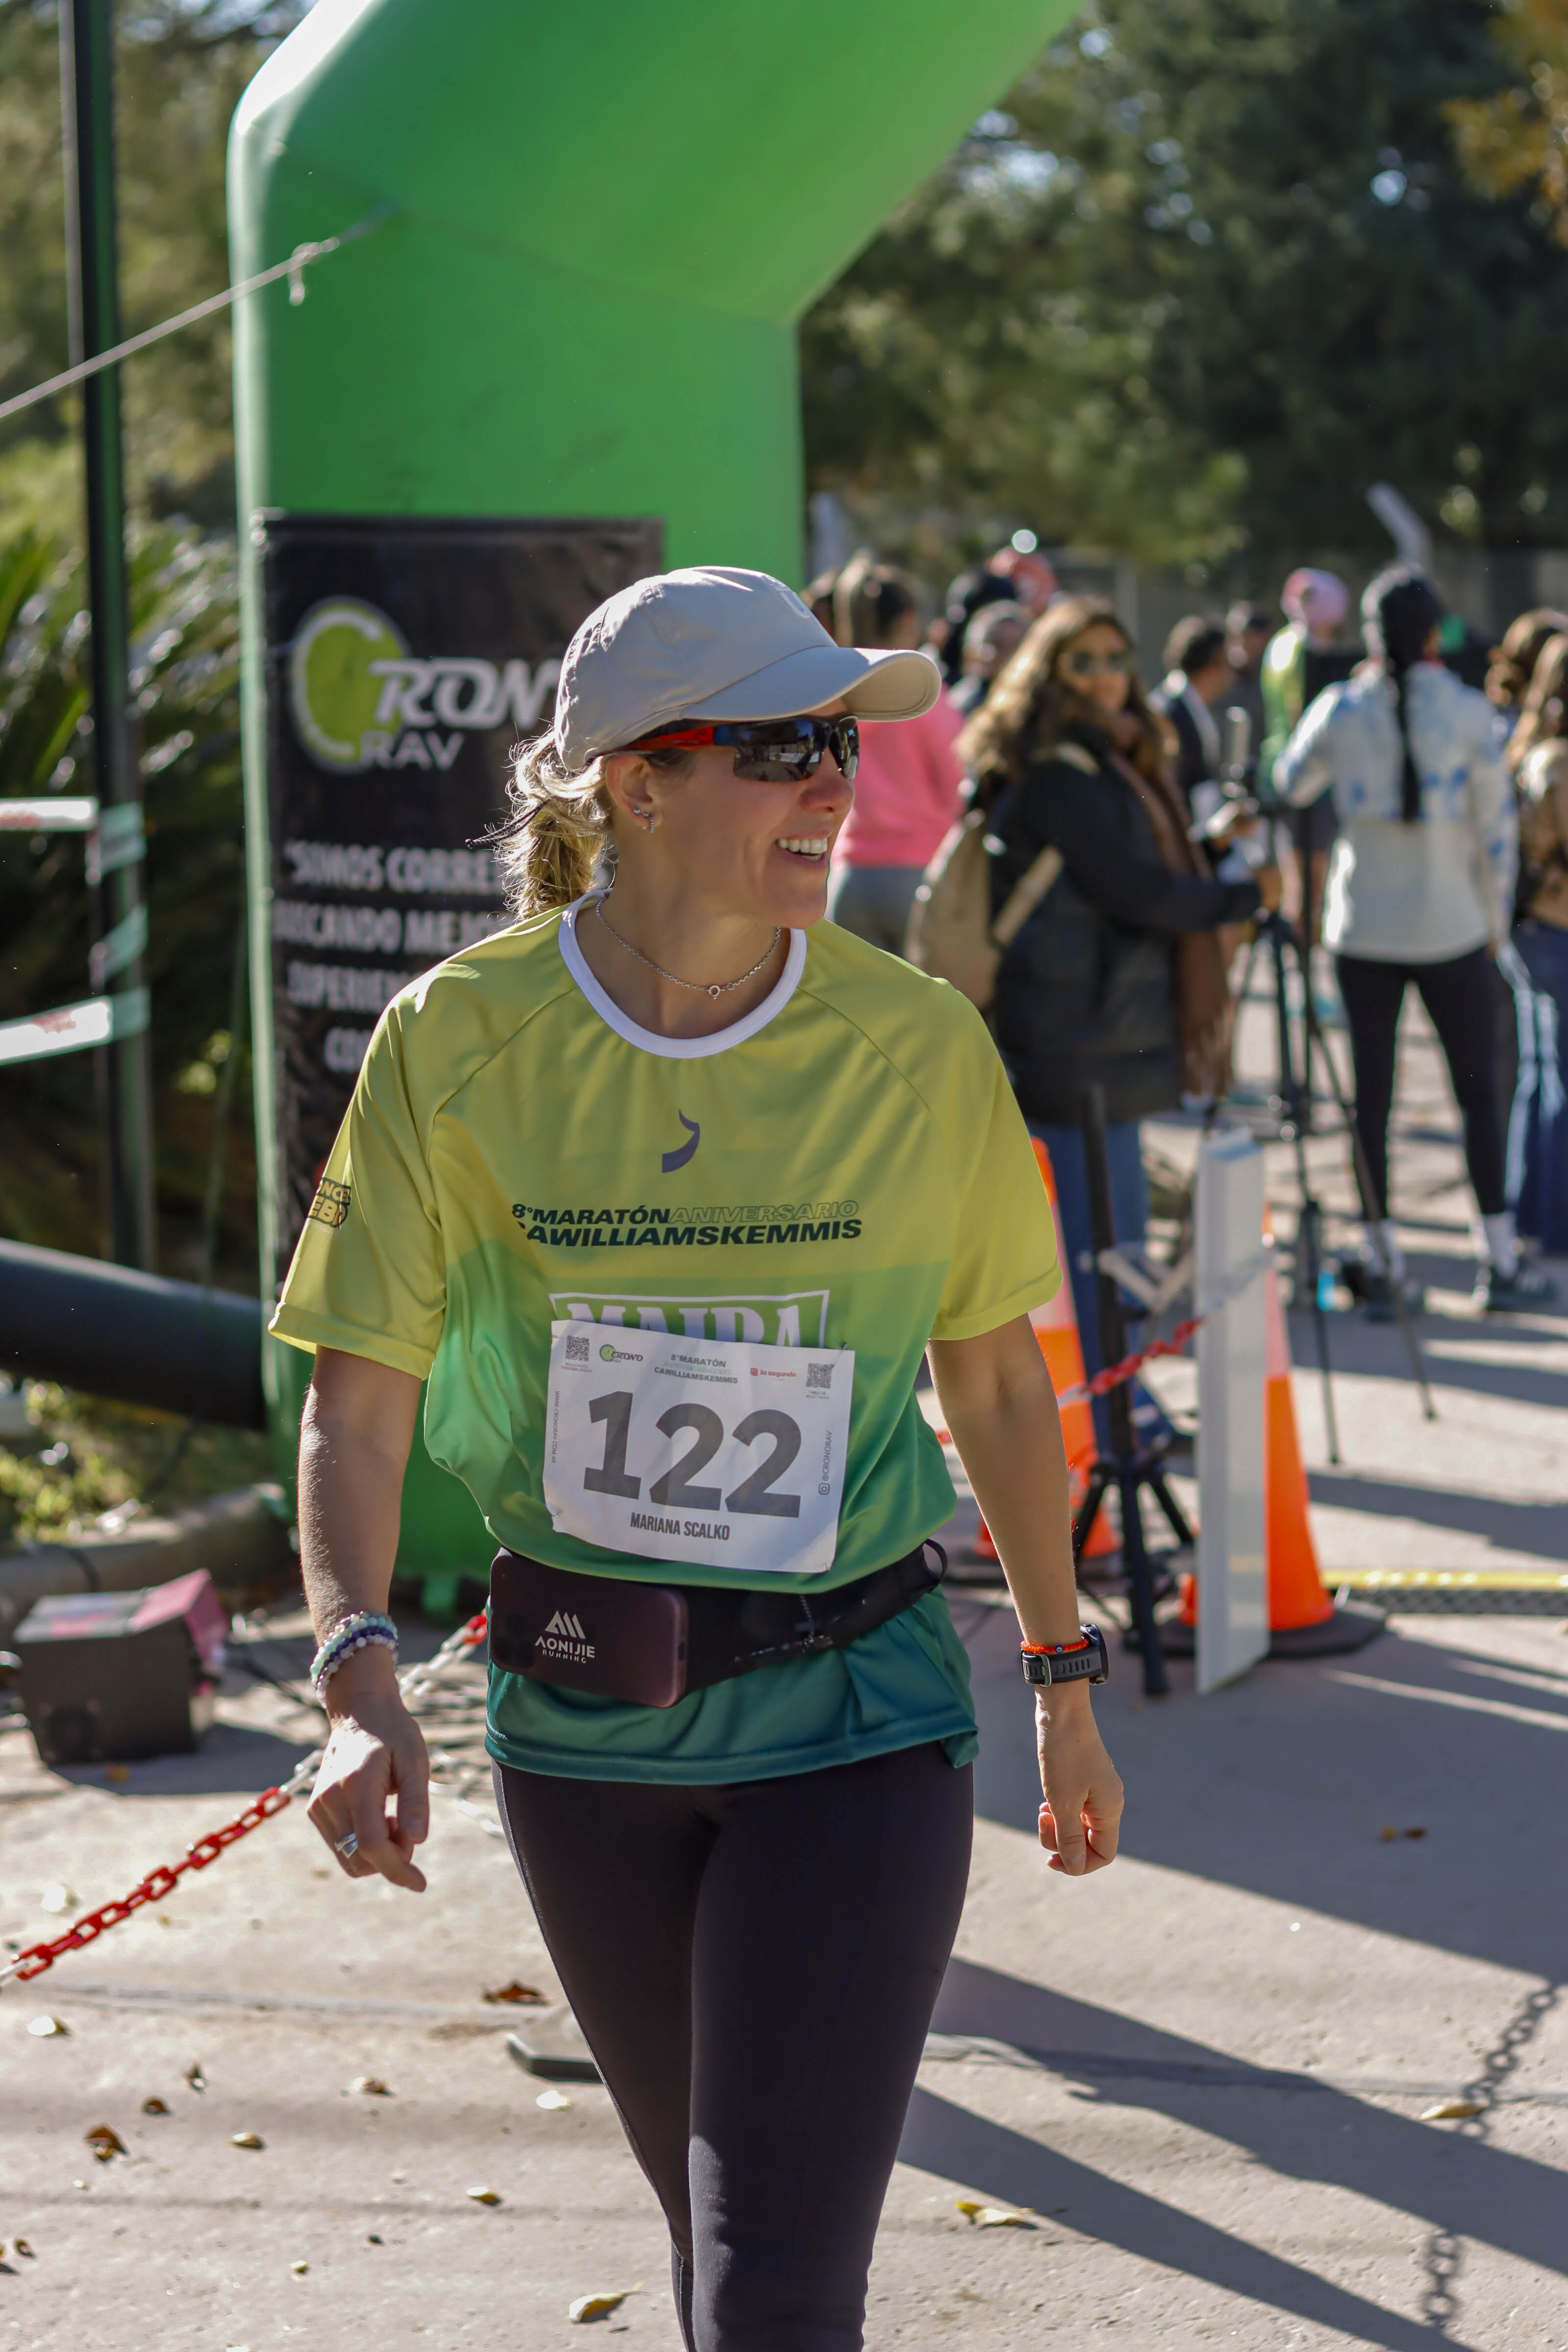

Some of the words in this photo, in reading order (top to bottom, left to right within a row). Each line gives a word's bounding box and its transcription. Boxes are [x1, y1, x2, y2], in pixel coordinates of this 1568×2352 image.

[359, 731, 464, 769] RAV
[517, 1219, 862, 1247] AWILLIAMSKEMMIS
[654, 1367, 738, 1384] CAWILLIAMSKEMMIS
[583, 1391, 802, 1518] 122
[630, 1512, 681, 1535] MARIANA
[684, 1521, 730, 1541] SCALKO
[535, 1636, 595, 1658] AONIJIE
[542, 1649, 587, 1664] RUNNING
